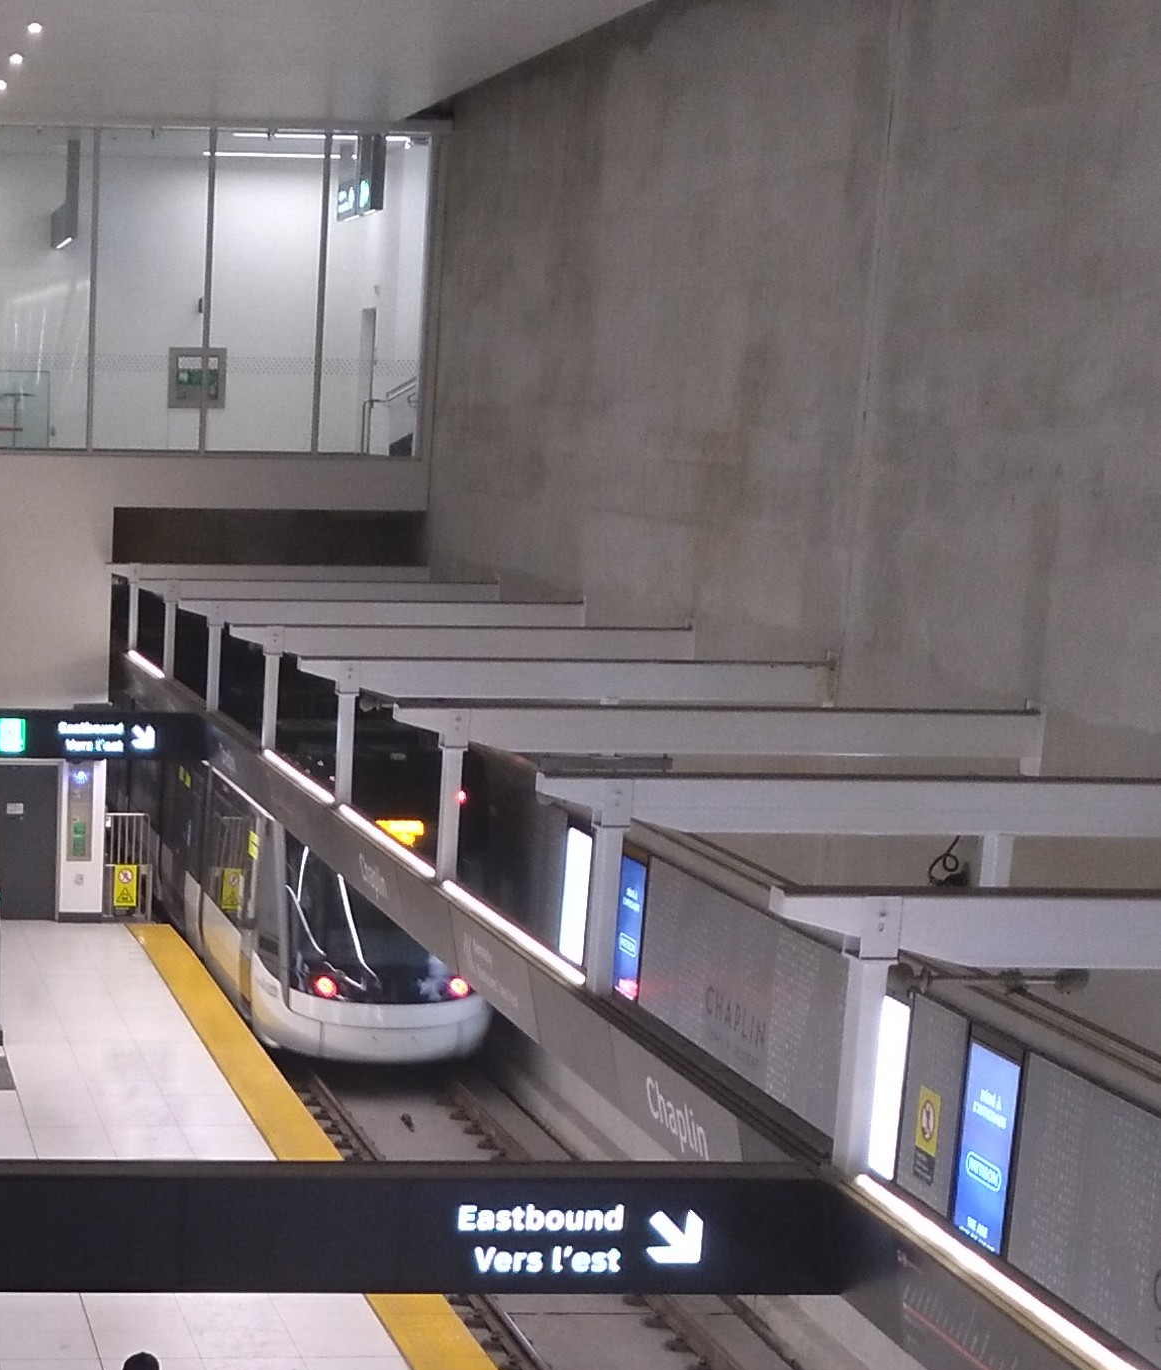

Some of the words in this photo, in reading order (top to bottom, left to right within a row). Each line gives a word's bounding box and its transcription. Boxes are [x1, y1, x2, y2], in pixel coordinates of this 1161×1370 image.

[706, 985, 767, 1049] CHAPLIN
[645, 1075, 710, 1162] Chaplin
[457, 1203, 625, 1231] Eastbound
[474, 1246, 544, 1273] Vers
[551, 1245, 622, 1273] l'est
